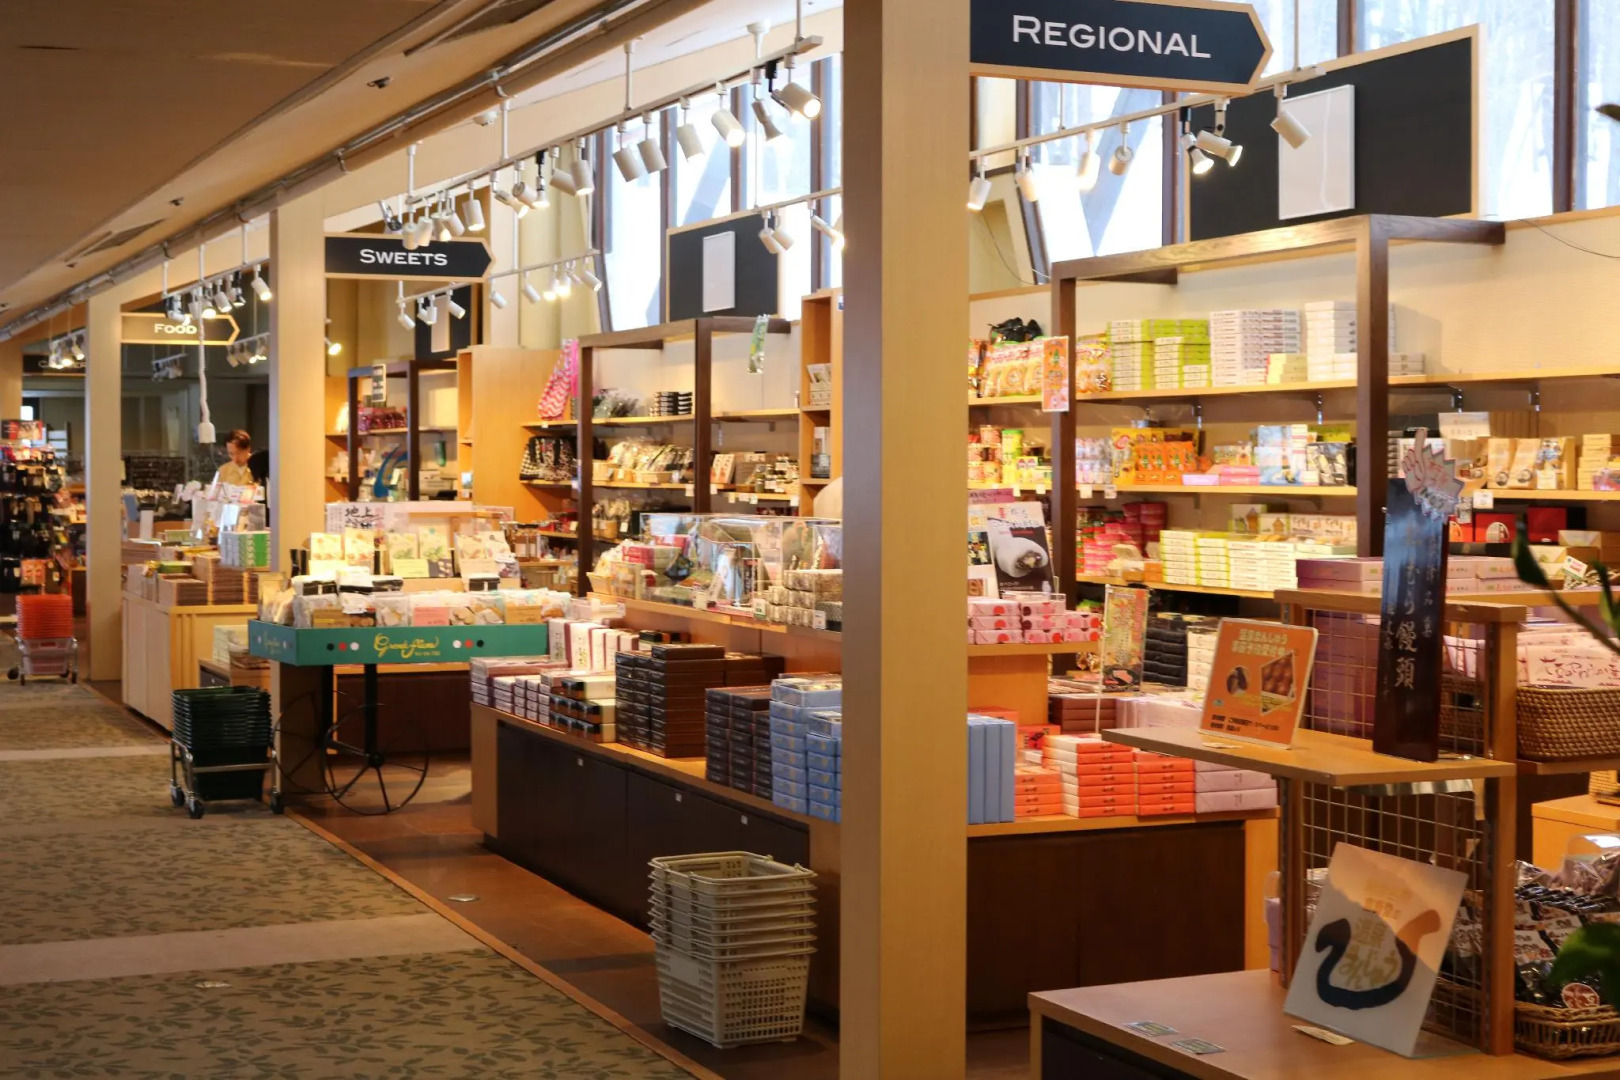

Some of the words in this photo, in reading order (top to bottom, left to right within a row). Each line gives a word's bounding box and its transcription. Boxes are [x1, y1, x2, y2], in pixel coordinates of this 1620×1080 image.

[1012, 14, 1211, 58] REGIONAL
[359, 247, 448, 267] SWEETS
[154, 323, 197, 335] FOOD
